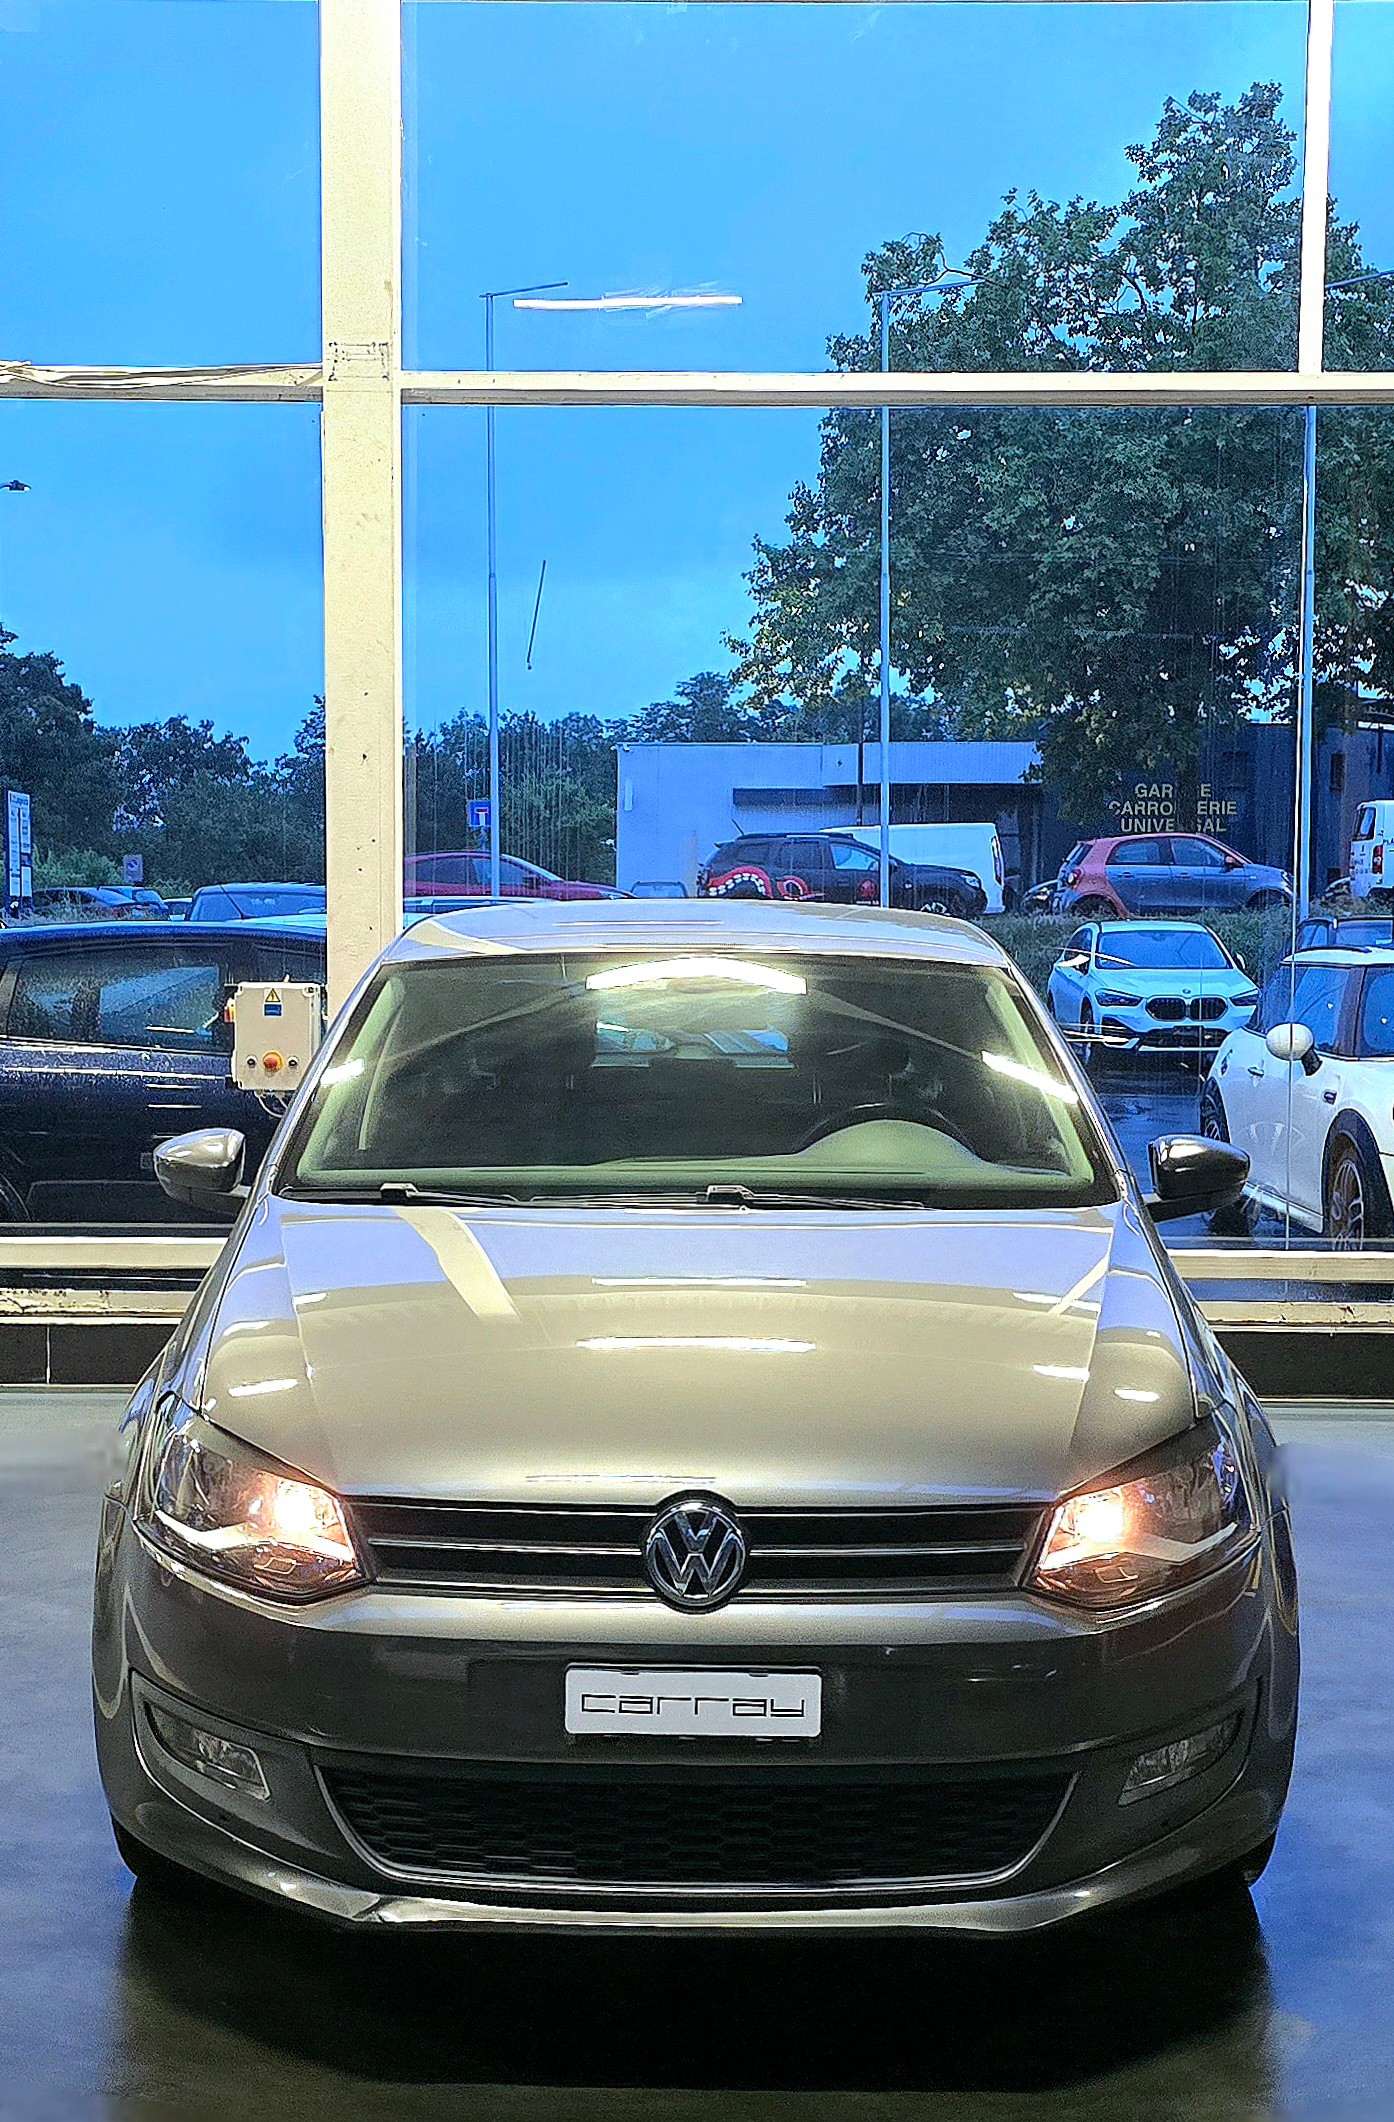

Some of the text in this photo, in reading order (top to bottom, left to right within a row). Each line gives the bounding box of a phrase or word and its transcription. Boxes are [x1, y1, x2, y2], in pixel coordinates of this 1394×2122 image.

[1134, 783, 1212, 798] GARE
[1108, 801, 1238, 815] CARROERIE
[650, 1509, 737, 1597] VW
[581, 1693, 805, 1717] carray
